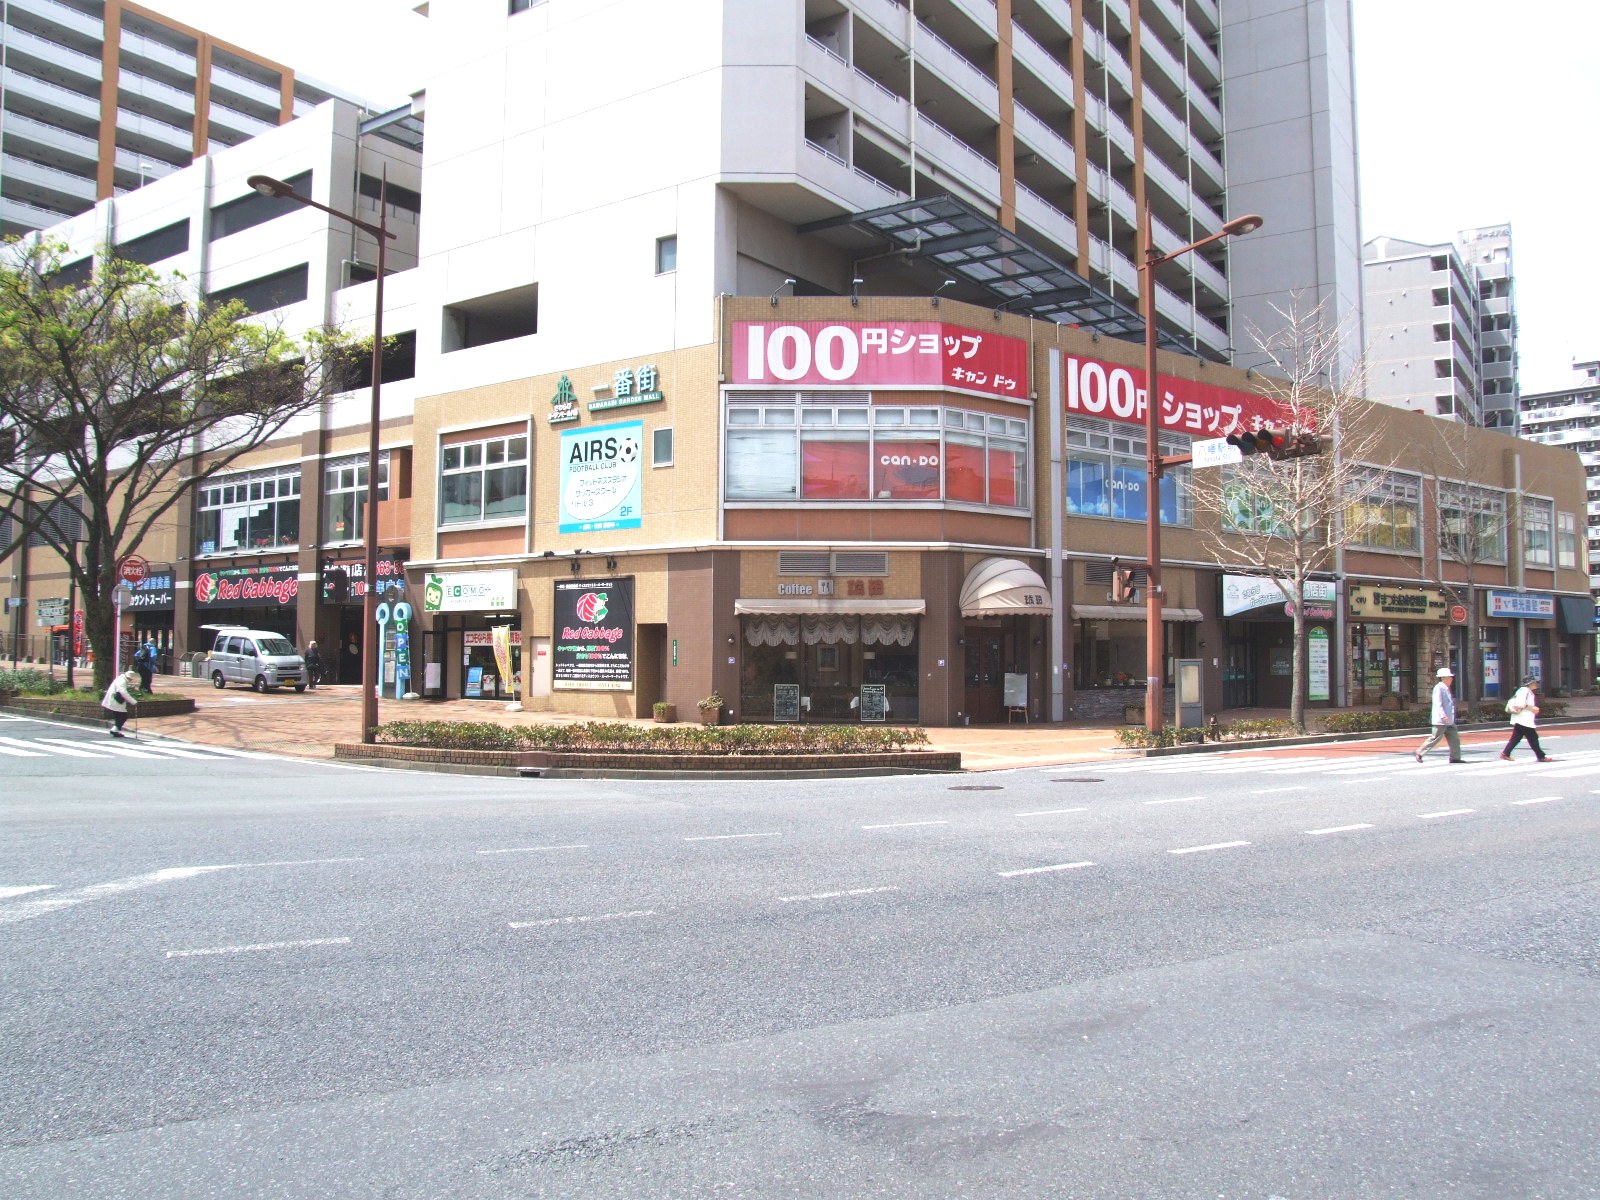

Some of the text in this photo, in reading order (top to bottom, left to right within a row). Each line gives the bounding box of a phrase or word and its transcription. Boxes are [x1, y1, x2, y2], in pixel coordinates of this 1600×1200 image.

[748, 325, 981, 381] 100円ショップ
[590, 364, 657, 397] 一番街
[618, 396, 643, 405] GARDEN
[644, 393, 660, 401] MALL
[569, 437, 618, 463] AIRS
[569, 461, 617, 473] FOOTBALL CLUB
[620, 506, 633, 517] 2F
[122, 565, 144, 576] 消火栓
[217, 579, 243, 599] Red
[242, 576, 299, 604] Cabbage
[778, 583, 813, 595] Coffee
[562, 626, 623, 643] Red Cabbage
[396, 622, 409, 677] OPEN
